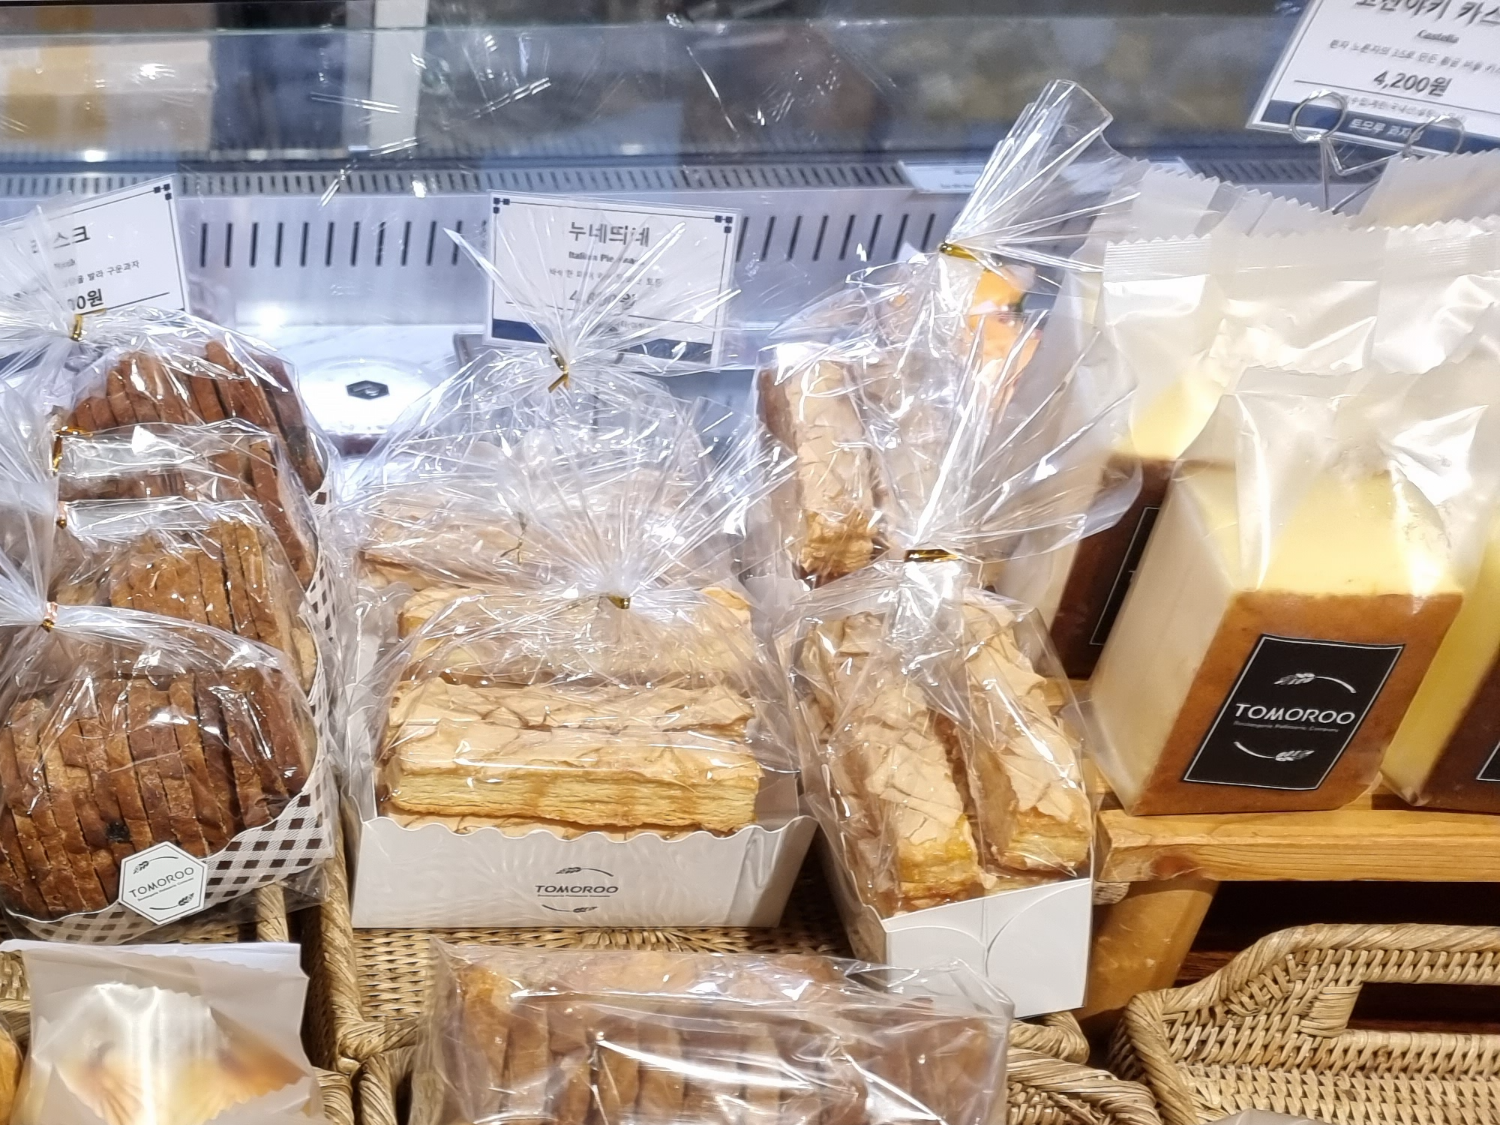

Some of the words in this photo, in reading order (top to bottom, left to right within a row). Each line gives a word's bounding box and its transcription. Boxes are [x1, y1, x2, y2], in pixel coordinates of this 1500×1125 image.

[1373, 70, 1452, 97] 4,200원
[1235, 703, 1355, 725] TOMOROO
[128, 867, 195, 898] TOMOROO
[534, 885, 619, 894] TOMOROO
